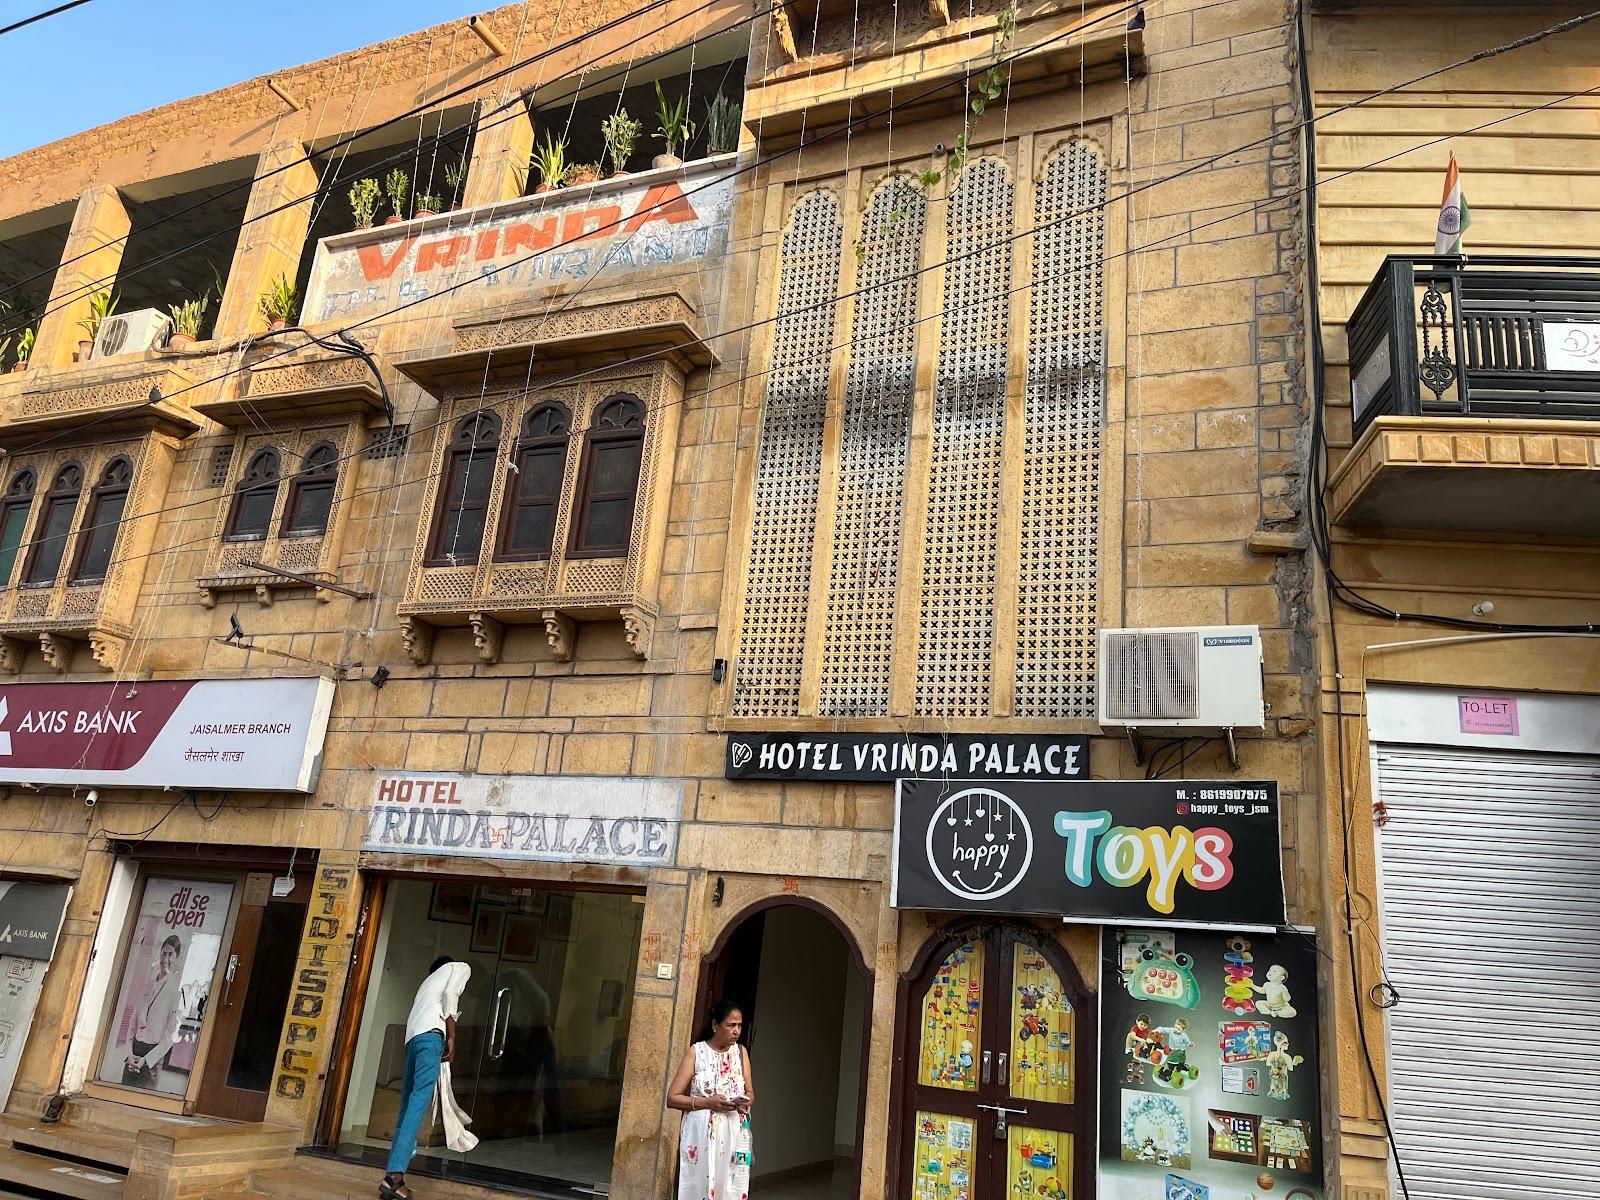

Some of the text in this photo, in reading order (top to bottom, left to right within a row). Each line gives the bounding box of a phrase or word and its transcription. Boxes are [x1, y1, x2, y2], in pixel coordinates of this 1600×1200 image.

[356, 180, 700, 283] VRINDA
[1462, 701, 1509, 714] TO-LET
[17, 710, 143, 734] AXIS BANK
[190, 723, 291, 735] JAISALMER BRANCH
[184, 747, 245, 762] जैसलमेर शाखा
[759, 742, 1082, 775] HOTEL VRINDA PALACE
[378, 779, 462, 805] HOTEL
[1176, 789, 1189, 800] M.
[1200, 789, 1268, 800] 8619907975
[1190, 803, 1269, 815] happy_toys_jsm
[502, 811, 668, 857] PALACE
[952, 832, 1010, 871] happy
[1055, 811, 1232, 913] Toys
[169, 886, 210, 911] dil se
[164, 907, 206, 929] open
[13, 929, 49, 940] AXIS BANK
[276, 867, 350, 1100] STD ISD PCO
